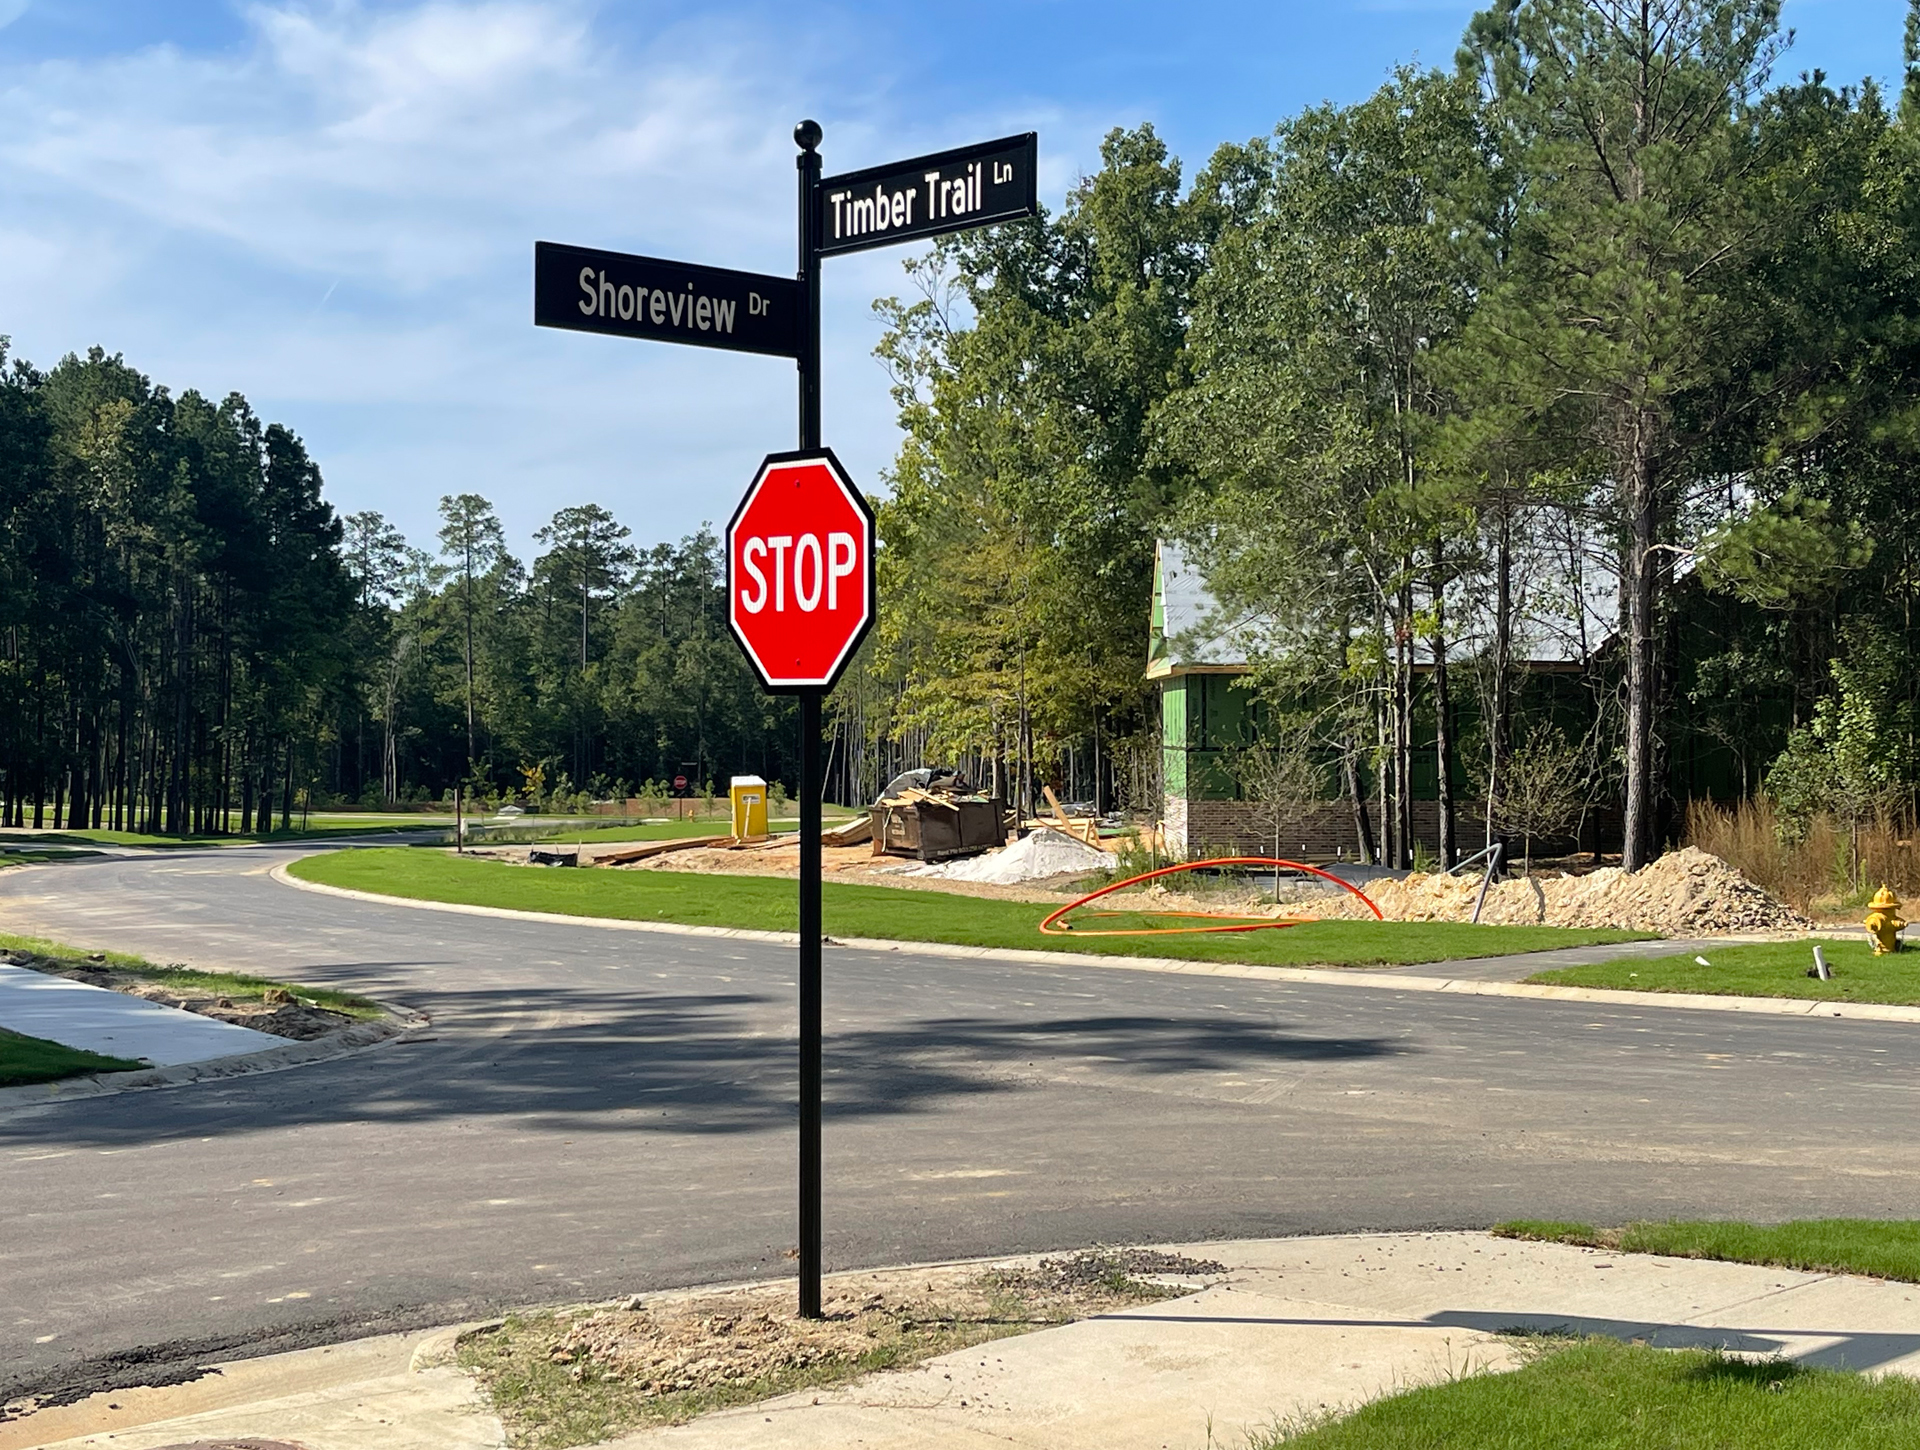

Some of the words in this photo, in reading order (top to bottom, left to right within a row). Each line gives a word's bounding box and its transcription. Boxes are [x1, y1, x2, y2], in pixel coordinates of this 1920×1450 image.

[830, 184, 917, 239] Timber
[924, 161, 982, 220] Trail
[993, 161, 1013, 185] Ln
[578, 266, 736, 334] Shoreview
[749, 292, 771, 316] Dr
[741, 531, 857, 614] STOP
